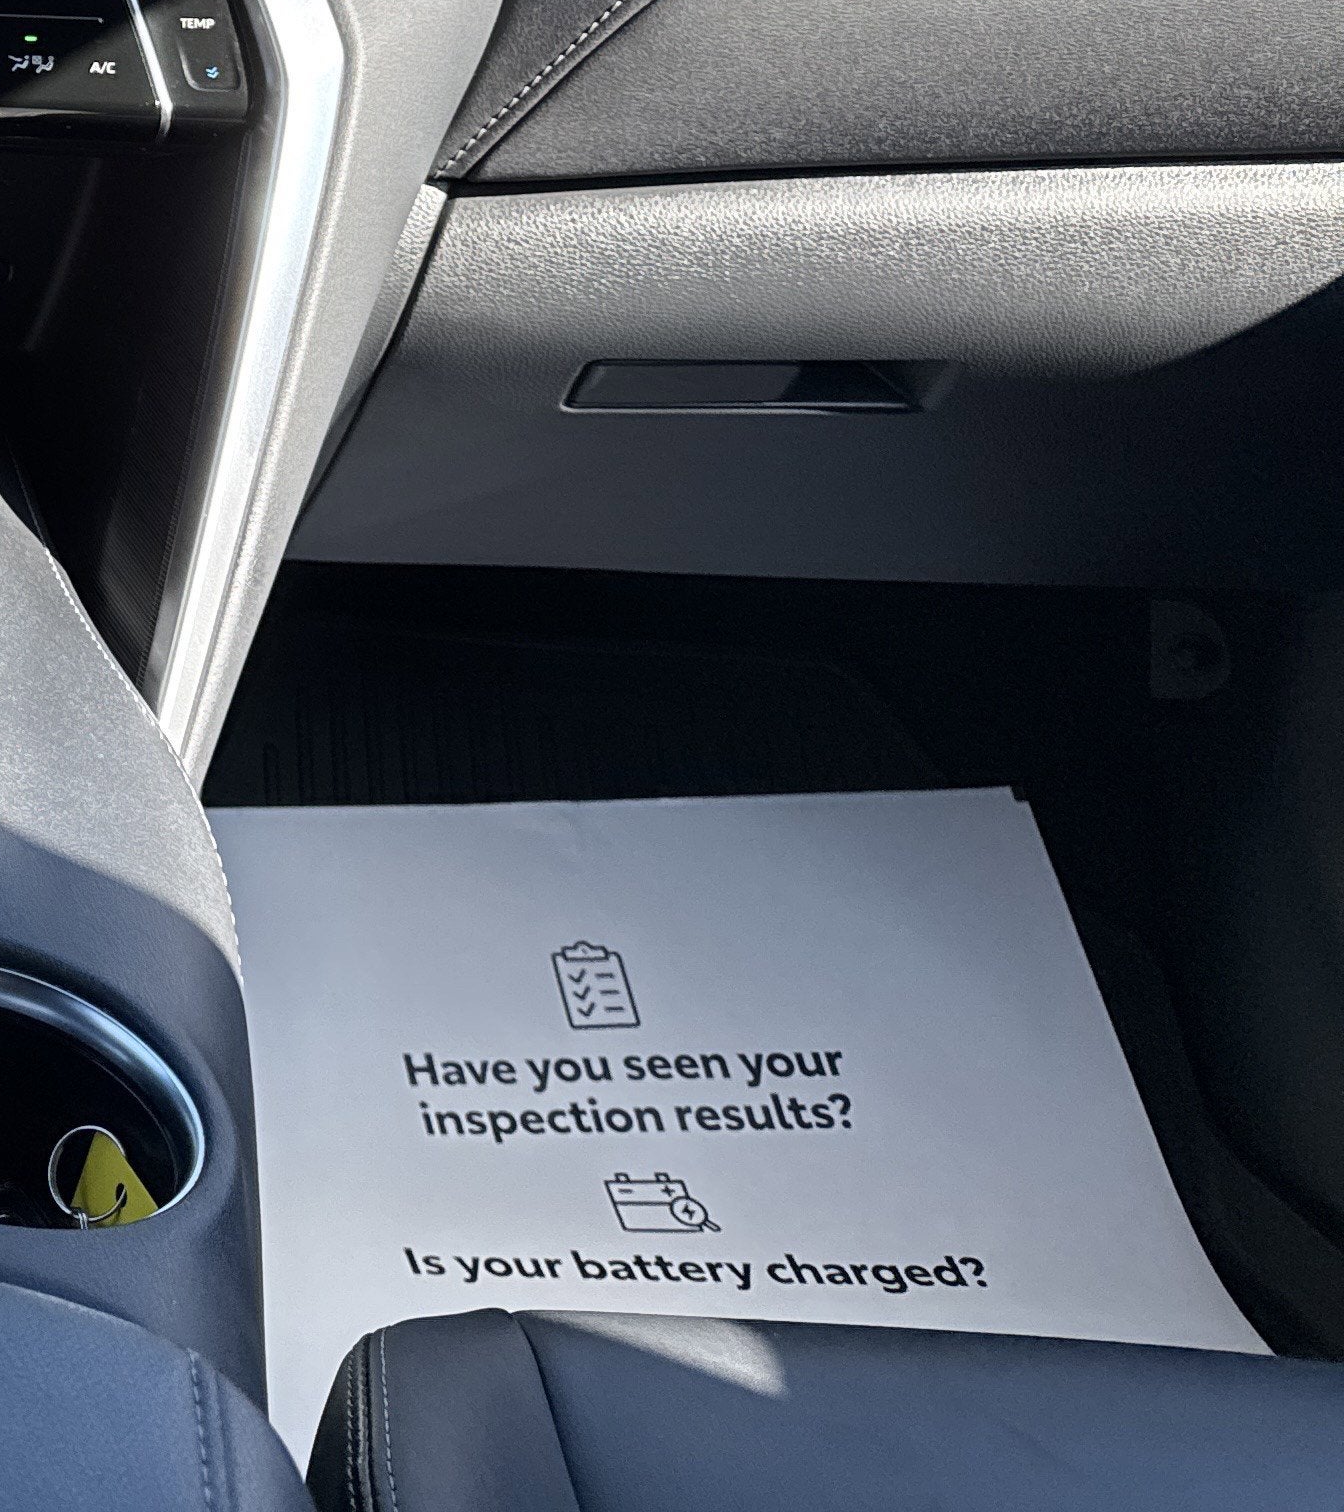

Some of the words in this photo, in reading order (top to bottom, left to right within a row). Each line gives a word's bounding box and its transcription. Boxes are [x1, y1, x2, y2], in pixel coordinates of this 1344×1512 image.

[179, 17, 216, 30] TEMP
[89, 60, 116, 75] A/C
[402, 1051, 518, 1087] Have
[525, 1054, 613, 1094] you
[621, 1050, 732, 1082] seen
[736, 1049, 844, 1089] your
[419, 1097, 666, 1145] inspection
[673, 1091, 853, 1132] results?
[402, 1246, 447, 1278] Is
[453, 1250, 564, 1283] your
[570, 1248, 753, 1292] battery
[764, 1252, 989, 1294] charged?
